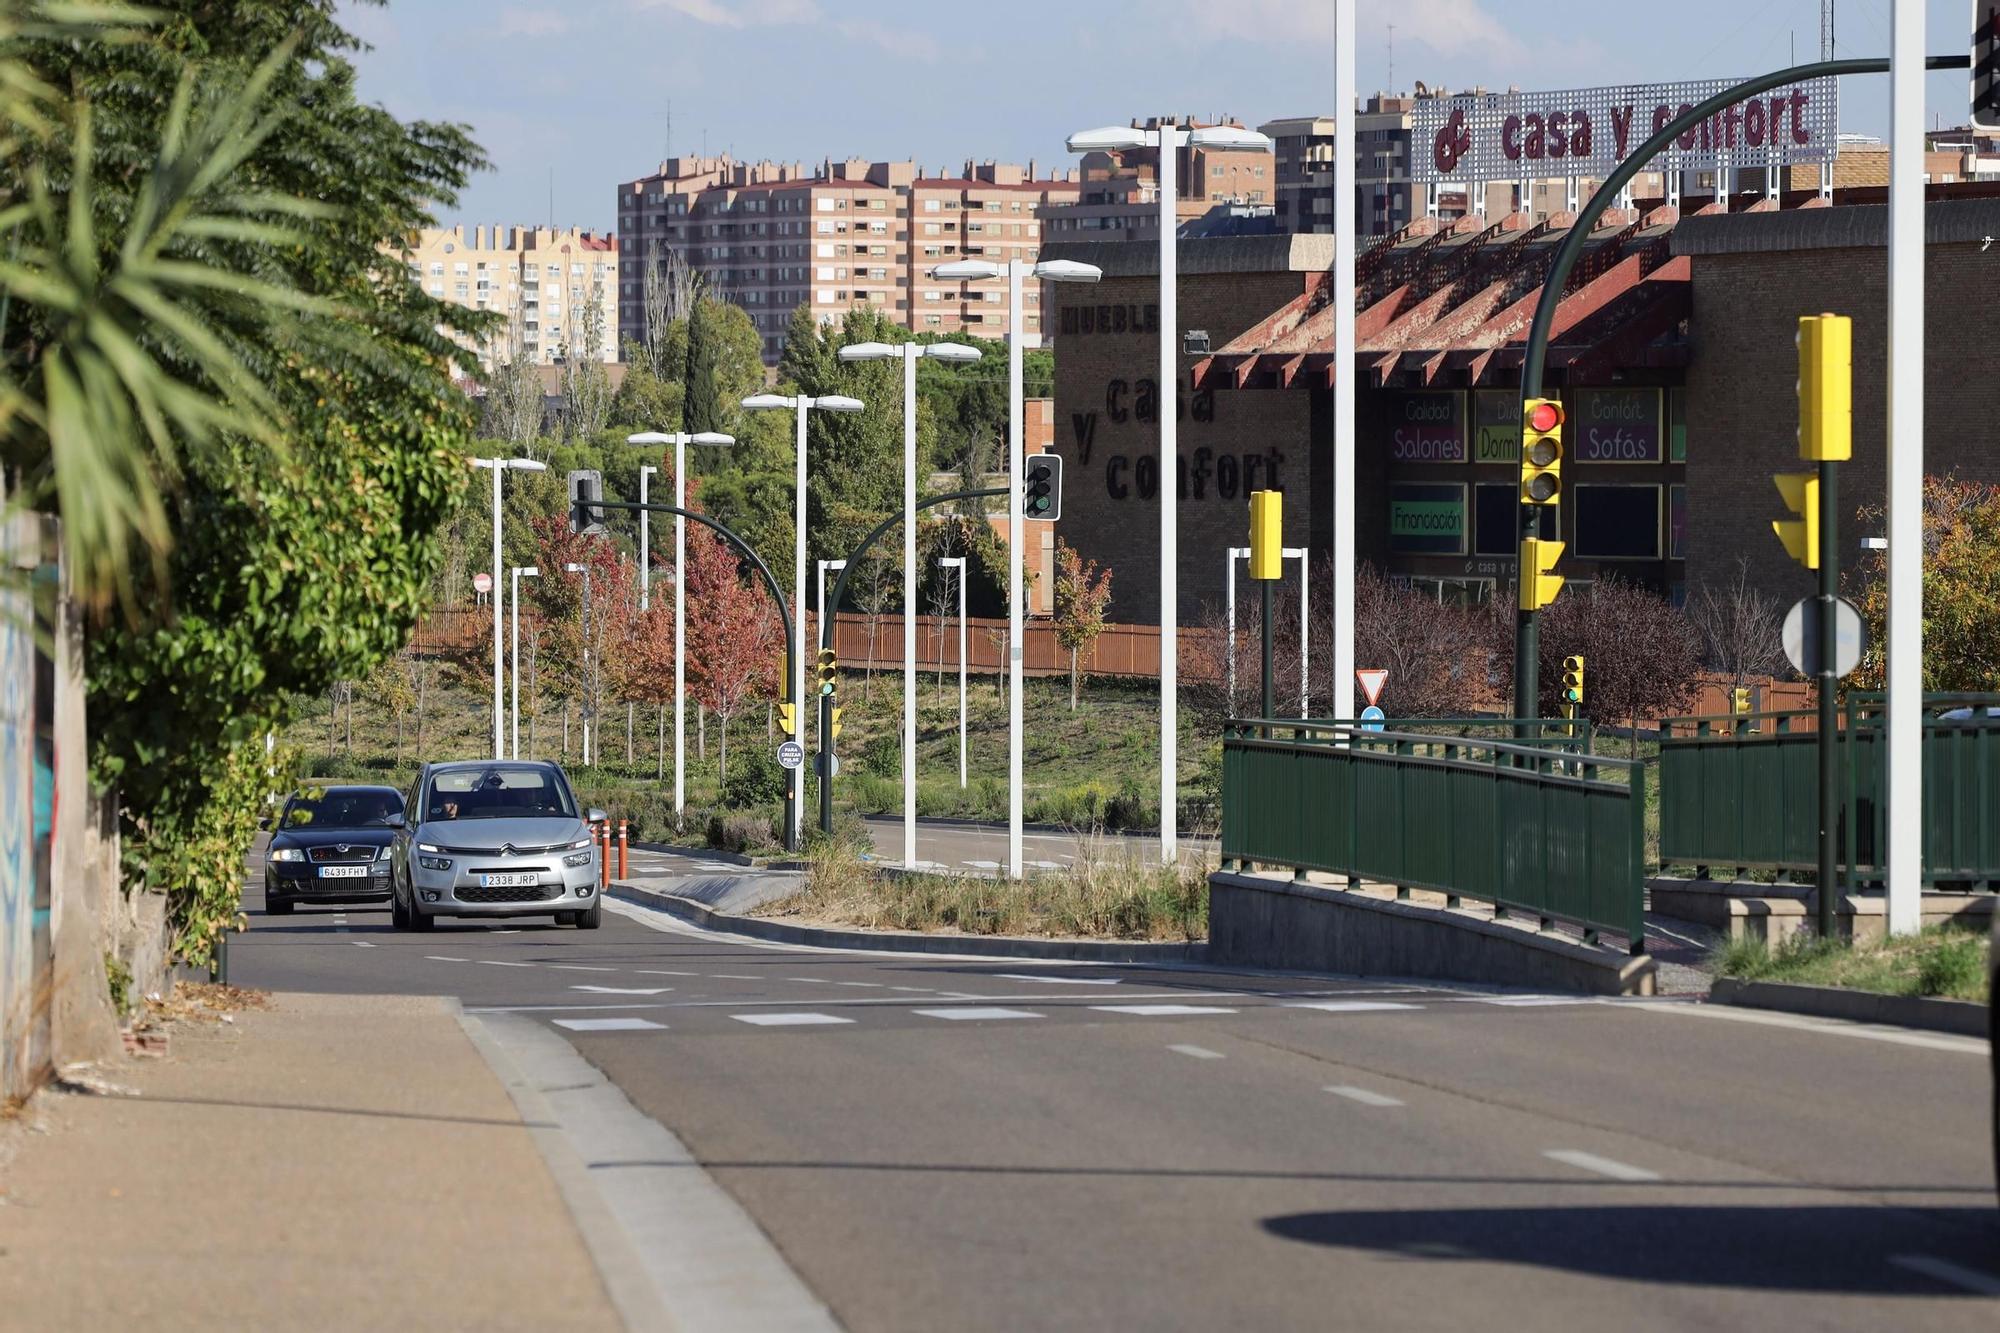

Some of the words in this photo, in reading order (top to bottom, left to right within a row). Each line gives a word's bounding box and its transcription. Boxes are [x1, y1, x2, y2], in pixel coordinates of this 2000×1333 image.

[1501, 109, 1592, 160] casa
[1406, 400, 1450, 421] Calidad
[1394, 428, 1461, 459] Salones
[1589, 428, 1647, 459] Sofás
[1394, 506, 1461, 530] Financiación
[1478, 562, 1497, 573] casa
[324, 868, 346, 877] 6439
[348, 867, 365, 876] FHY
[488, 875, 513, 886] 2338
[517, 875, 535, 885] JRP
